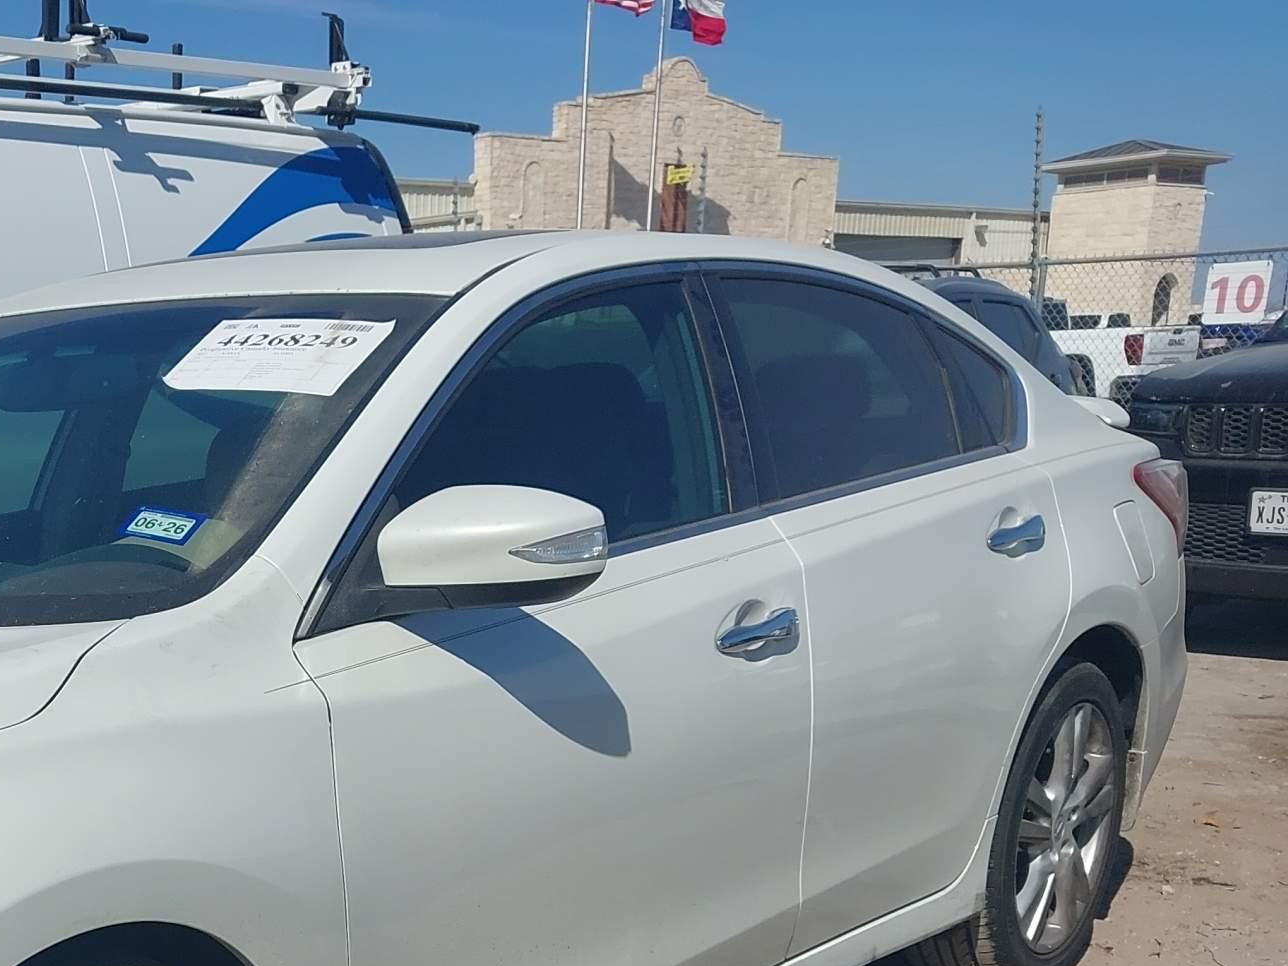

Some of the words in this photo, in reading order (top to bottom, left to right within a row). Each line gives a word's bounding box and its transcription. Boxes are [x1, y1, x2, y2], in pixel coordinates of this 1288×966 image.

[1210, 274, 1265, 314] 10
[217, 333, 359, 349] 44268249
[1255, 506, 1286, 525] XJS
